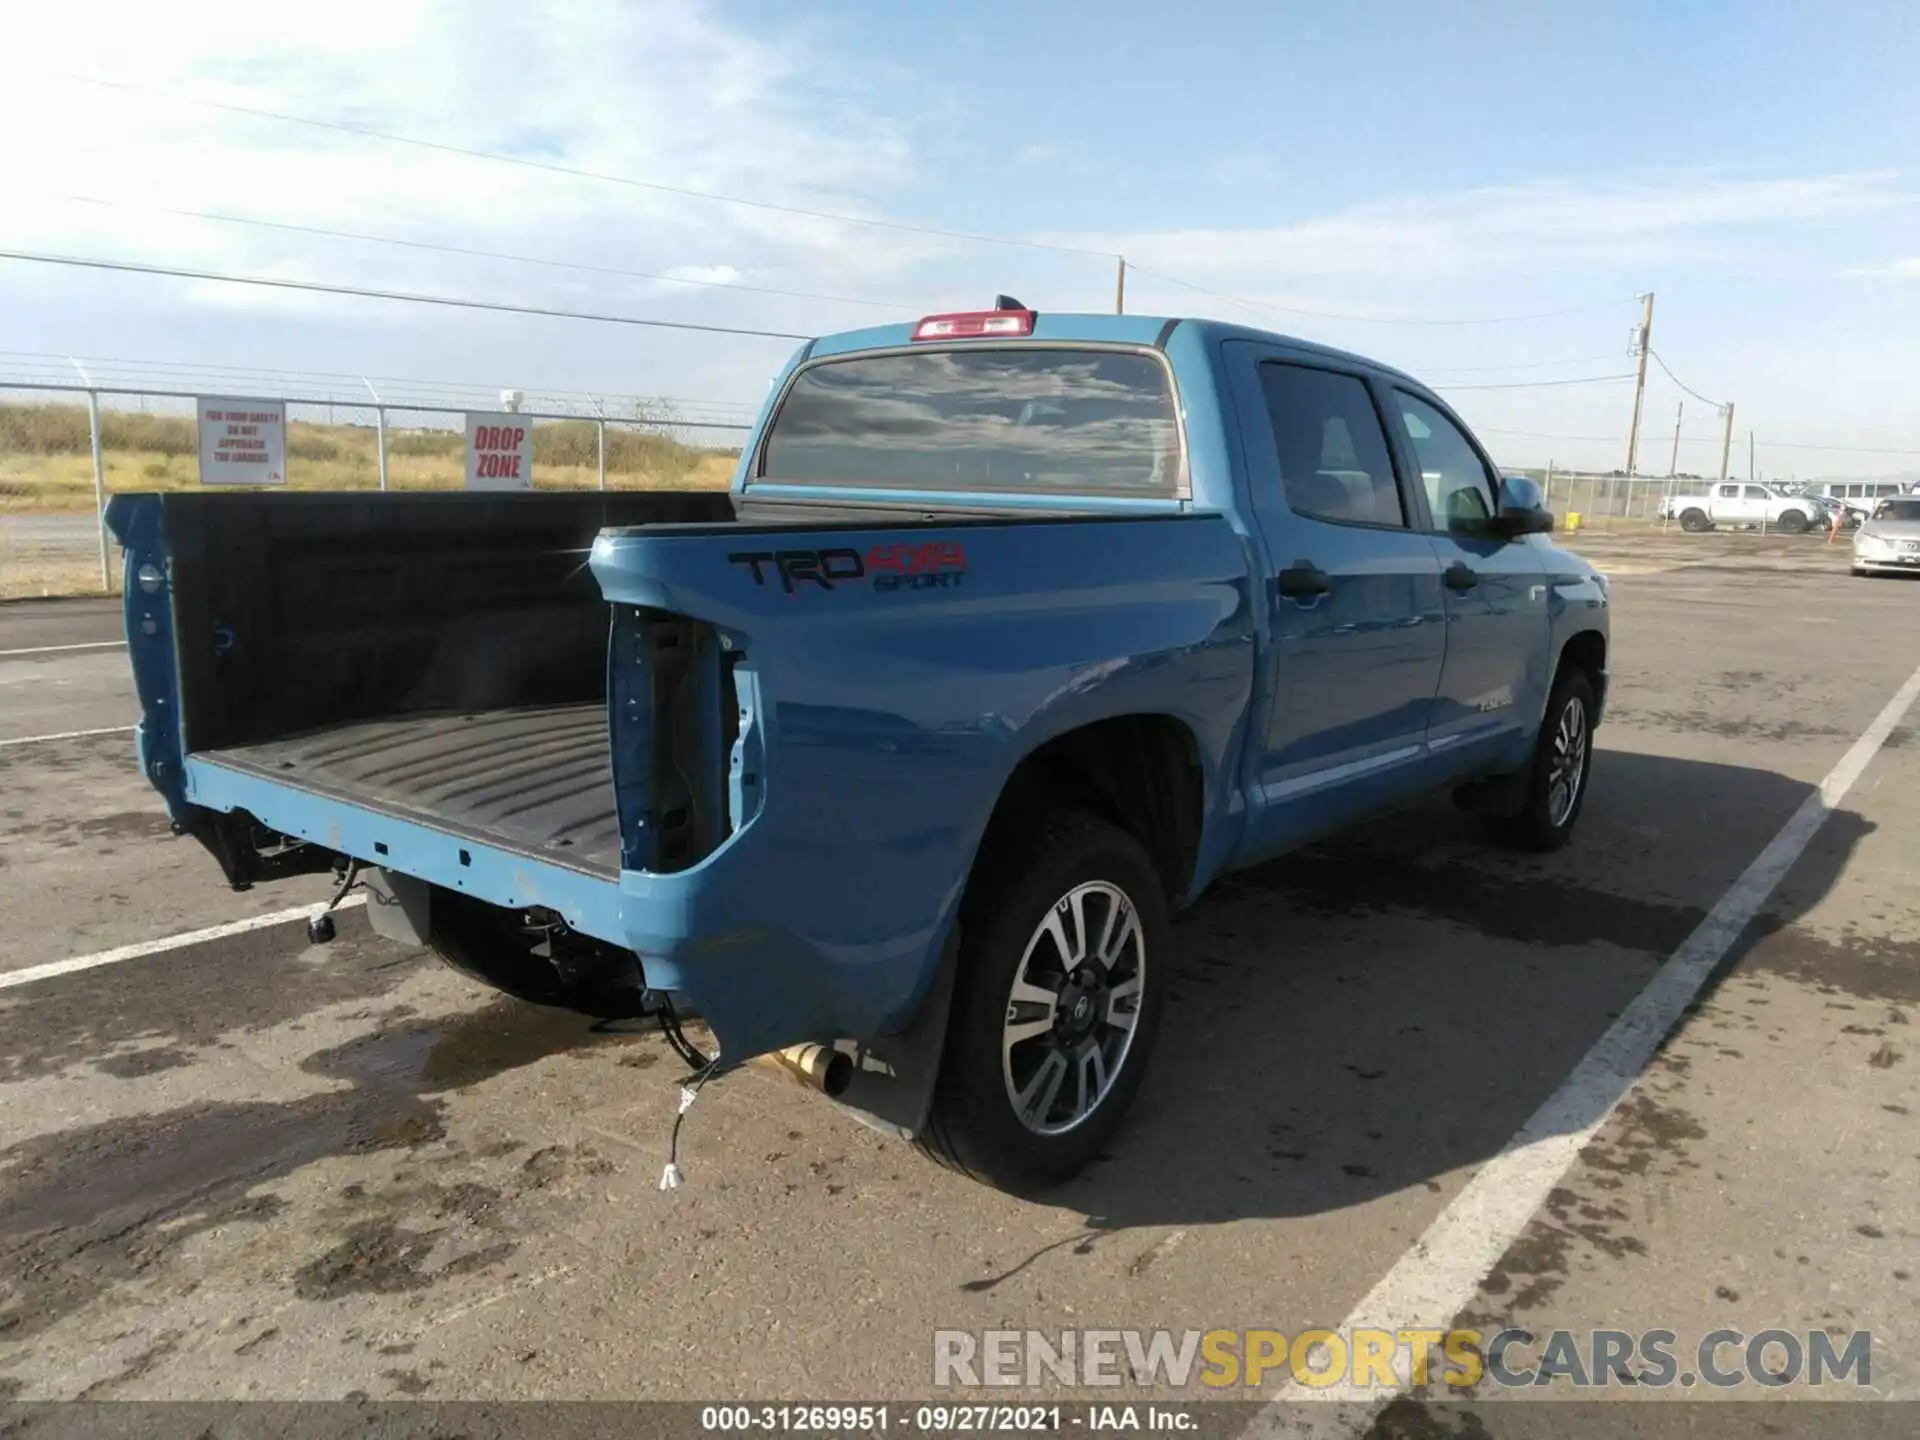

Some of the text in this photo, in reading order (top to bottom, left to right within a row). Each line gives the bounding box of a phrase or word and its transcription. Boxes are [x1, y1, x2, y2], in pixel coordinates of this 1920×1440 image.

[475, 426, 525, 451] DROP
[476, 454, 522, 478] ZONE
[728, 548, 865, 594] TRD
[873, 571, 966, 592] SPORT
